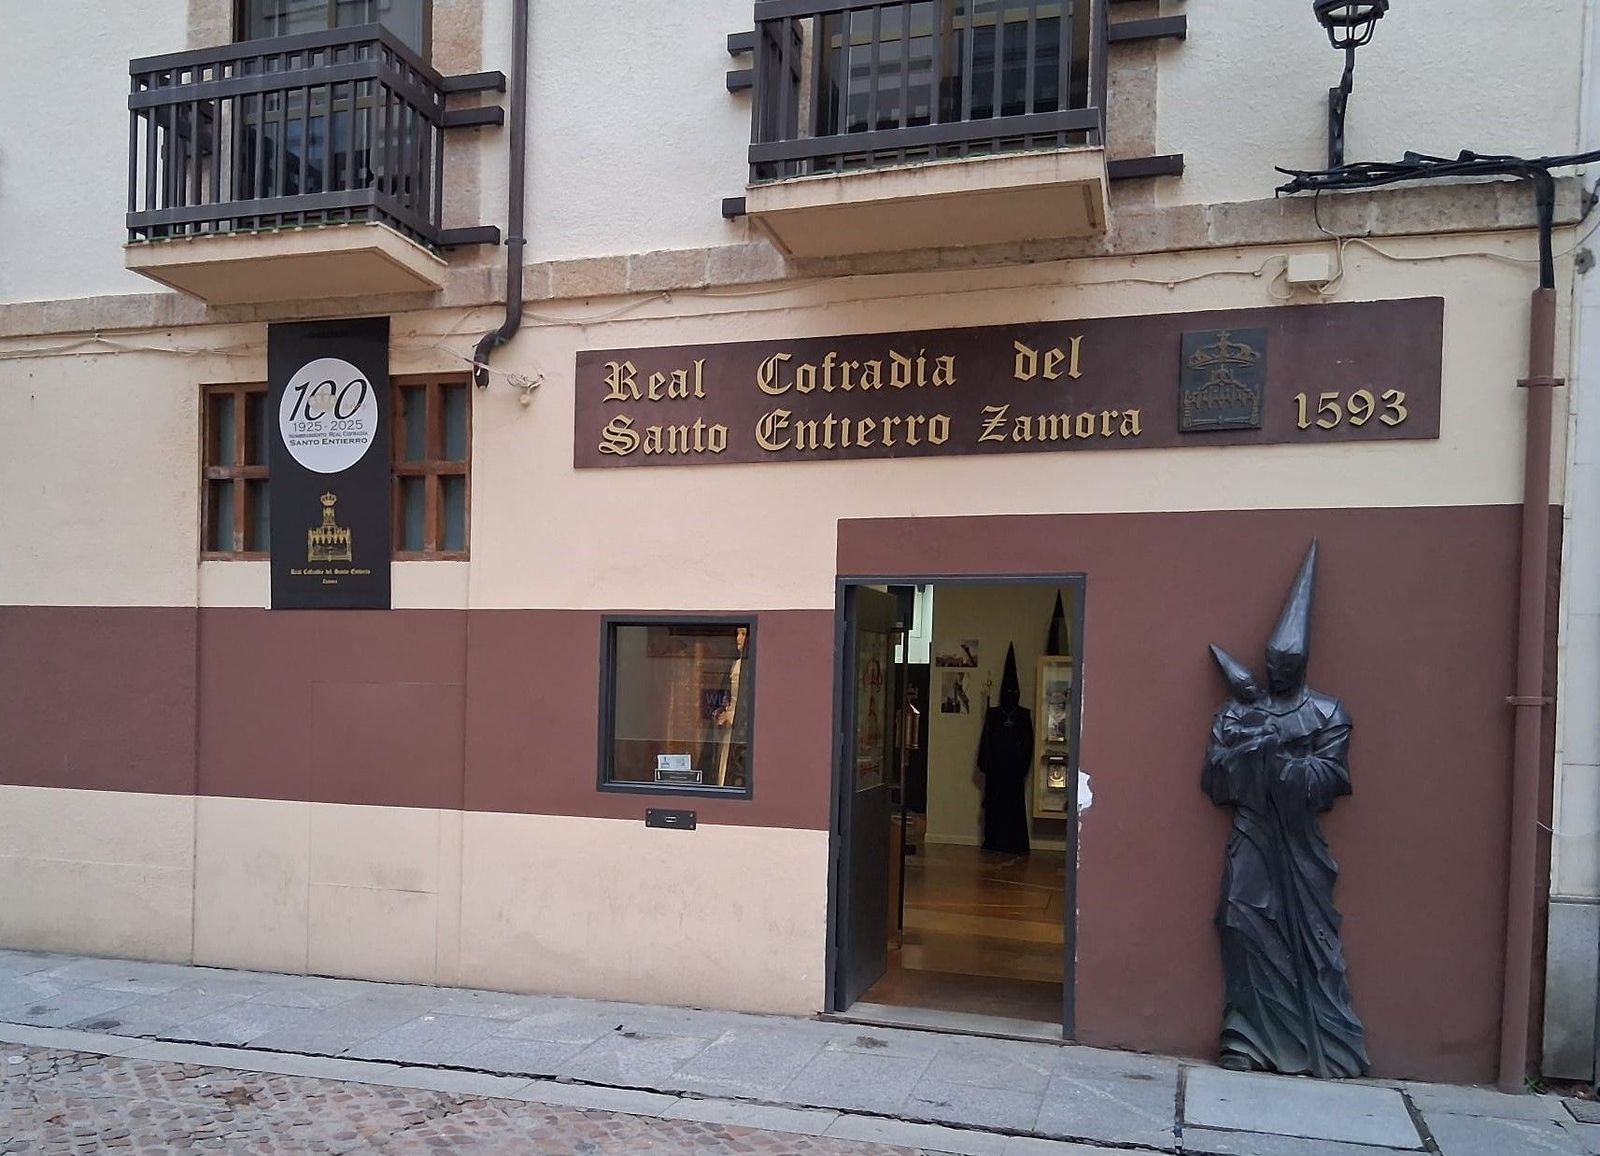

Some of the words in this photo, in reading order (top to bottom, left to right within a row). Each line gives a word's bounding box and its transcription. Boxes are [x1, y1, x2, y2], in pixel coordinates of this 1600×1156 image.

[602, 358, 707, 402] Real
[756, 348, 957, 395] Cofradía
[1012, 335, 1086, 382] del
[289, 378, 367, 421] 100
[1294, 388, 1409, 430] 1593
[293, 421, 322, 432] 1925
[330, 420, 363, 431] 2025
[598, 412, 728, 457] Santo
[755, 408, 951, 451] Entierro
[977, 404, 1143, 443] Zamora
